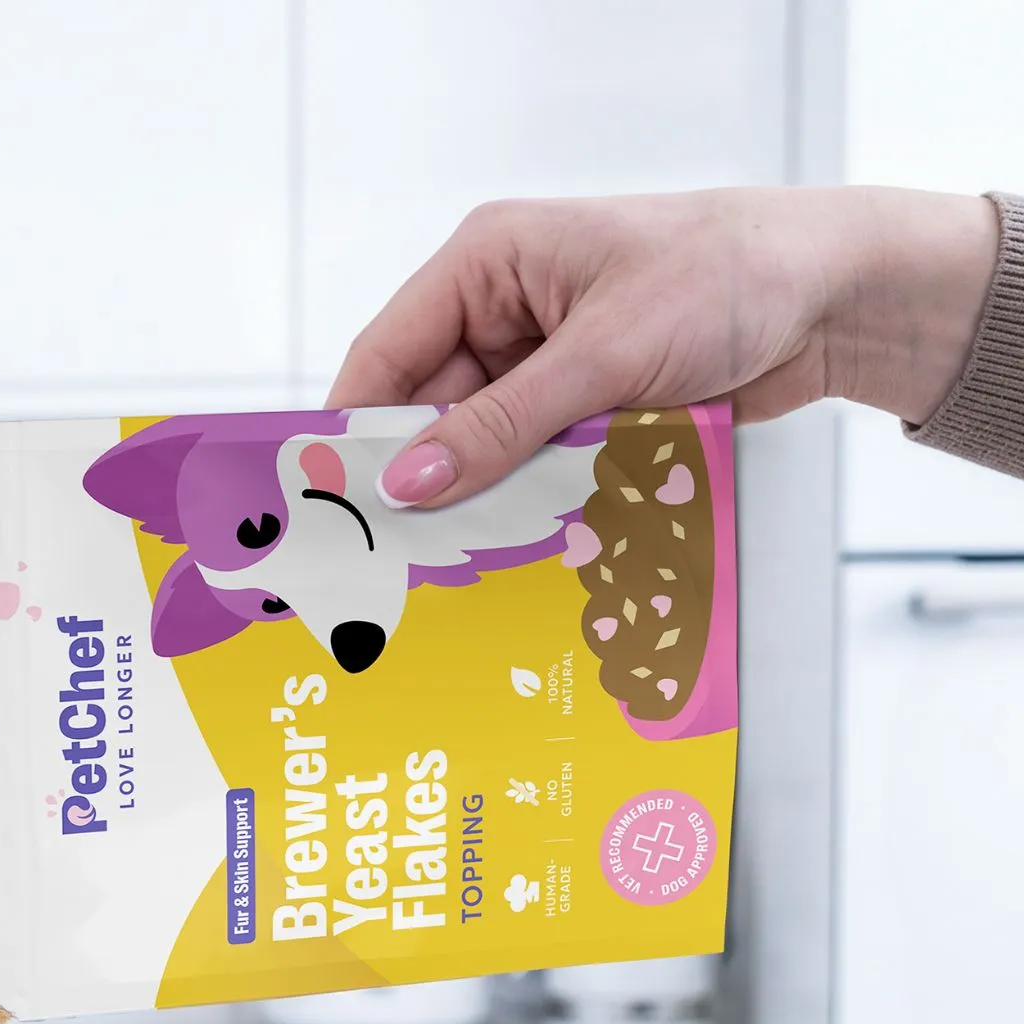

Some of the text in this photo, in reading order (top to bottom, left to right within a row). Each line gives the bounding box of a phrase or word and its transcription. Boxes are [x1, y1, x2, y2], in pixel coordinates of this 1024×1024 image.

[56, 616, 108, 835] PetChef
[116, 635, 135, 808] LOVE LONGER
[547, 664, 558, 703] 100%
[562, 650, 573, 715] NATURAL
[271, 673, 327, 941] Brewer's
[547, 780, 558, 800] NO
[561, 762, 572, 817] GLUTEN
[233, 797, 251, 935] Fur & Skin Support
[333, 772, 388, 936] Yeast
[392, 749, 447, 931] Flakes
[461, 794, 484, 924] TOPPING
[546, 858, 556, 917] HUMAN-
[608, 798, 674, 894] VET RECOMMENDED
[661, 811, 708, 896] DOG APPROVED
[560, 866, 571, 912] GRADE
